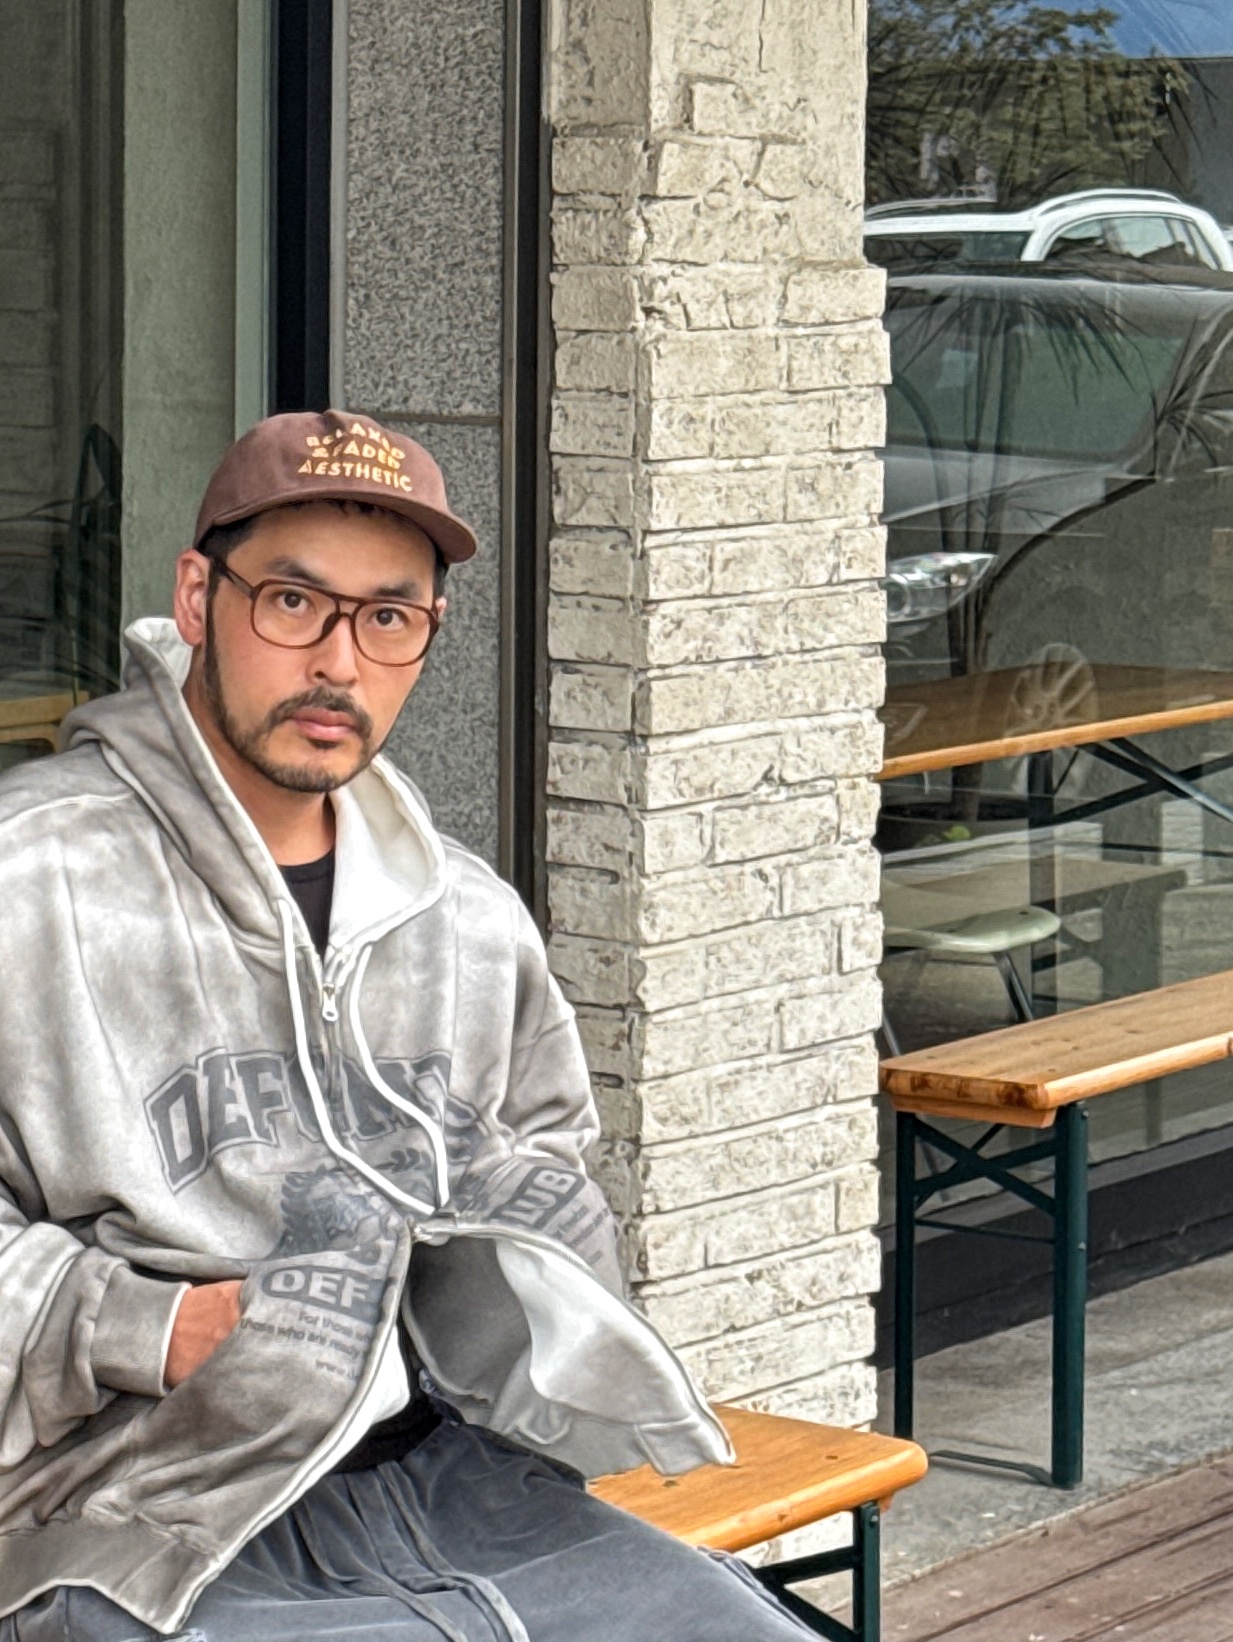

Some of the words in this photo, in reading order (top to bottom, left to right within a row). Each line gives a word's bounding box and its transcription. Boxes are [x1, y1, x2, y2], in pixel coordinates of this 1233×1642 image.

[297, 459, 413, 492] AESTHETIC
[269, 1269, 370, 1308] DEF
[501, 1168, 578, 1226] LUB
